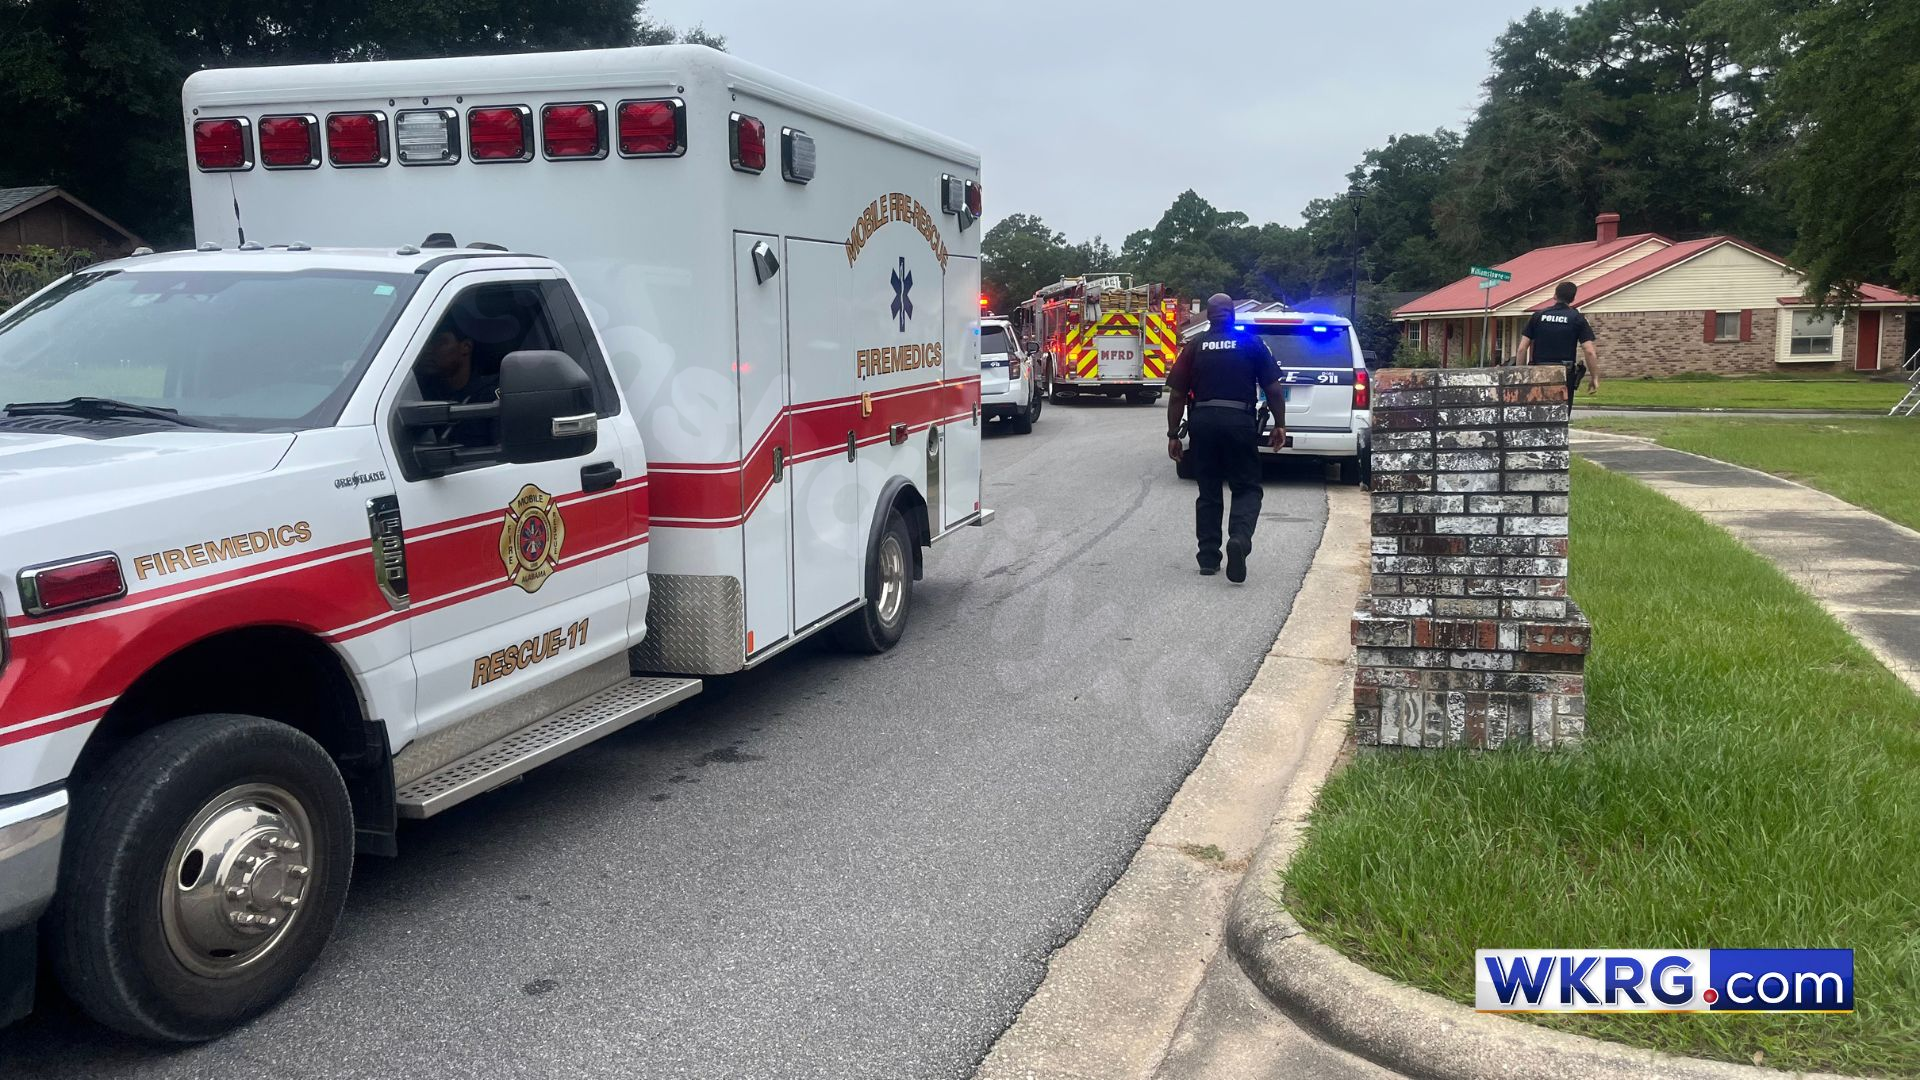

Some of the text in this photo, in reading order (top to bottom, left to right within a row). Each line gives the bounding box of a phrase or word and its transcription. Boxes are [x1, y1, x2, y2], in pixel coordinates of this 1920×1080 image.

[845, 193, 948, 275] MOBILE FIRE-RESCUE
[1541, 314, 1568, 324] POLICE
[1202, 340, 1237, 350] POLICE
[856, 342, 942, 379] FIREMEDICS
[1101, 350, 1134, 361] MFRD
[1317, 375, 1338, 384] 911
[517, 494, 544, 508] MOBILE
[133, 520, 312, 581] FIREMEDICS
[521, 569, 547, 584] ALABAMA
[471, 617, 589, 690] RESCUE-11
